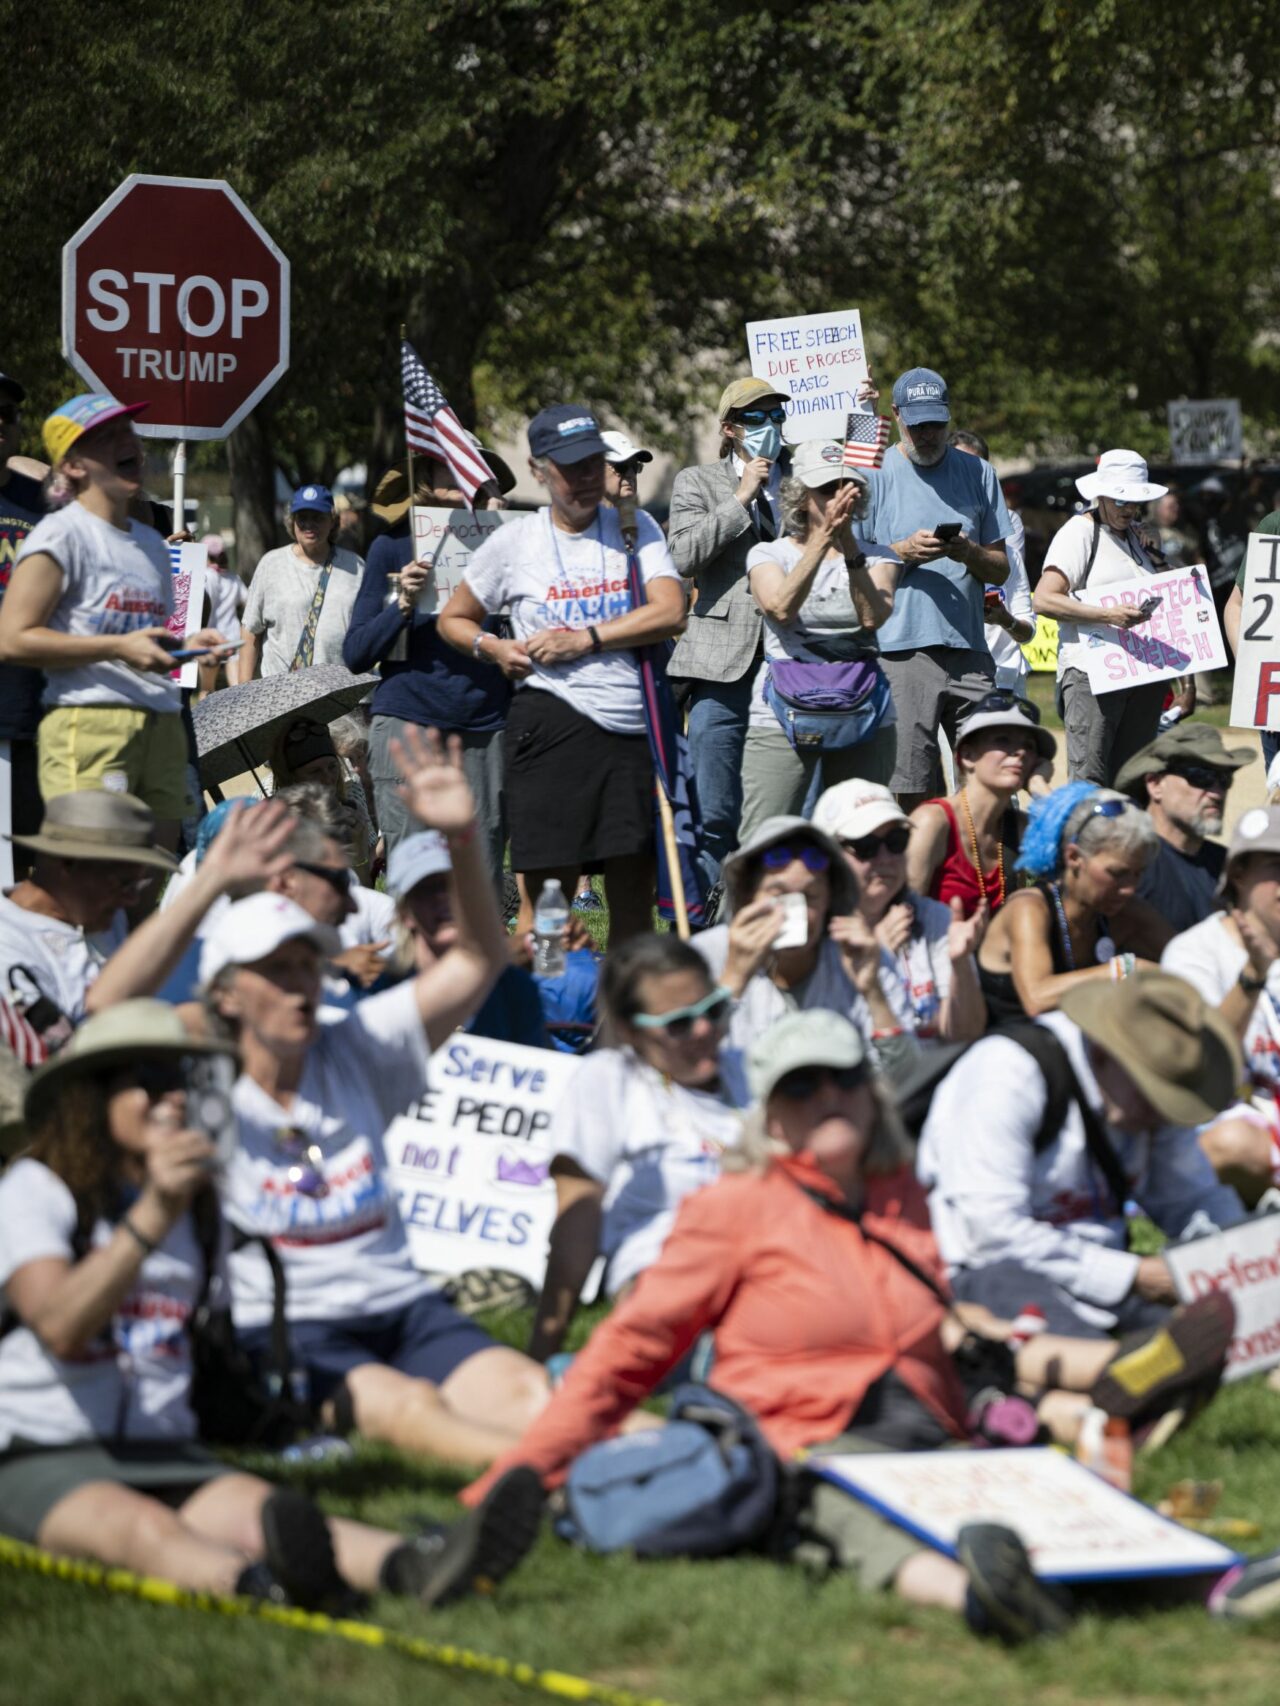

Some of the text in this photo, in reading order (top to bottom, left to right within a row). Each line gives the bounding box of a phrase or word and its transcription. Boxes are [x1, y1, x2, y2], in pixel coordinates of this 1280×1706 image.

[86, 268, 269, 339] STOP
[755, 329, 802, 354] FREE
[115, 346, 238, 384] TRUMP
[768, 347, 862, 377] DUE PROCESS
[784, 388, 859, 417] UMANITY
[789, 375, 829, 394] BASIC
[908, 387, 925, 397] PURA
[1099, 572, 1206, 610] PROTECT
[1243, 593, 1274, 641] 2
[1103, 631, 1213, 681] SPEECH
[443, 1045, 546, 1093] Serve
[452, 1095, 551, 1141] PEOP
[399, 1189, 533, 1246] ELVES
